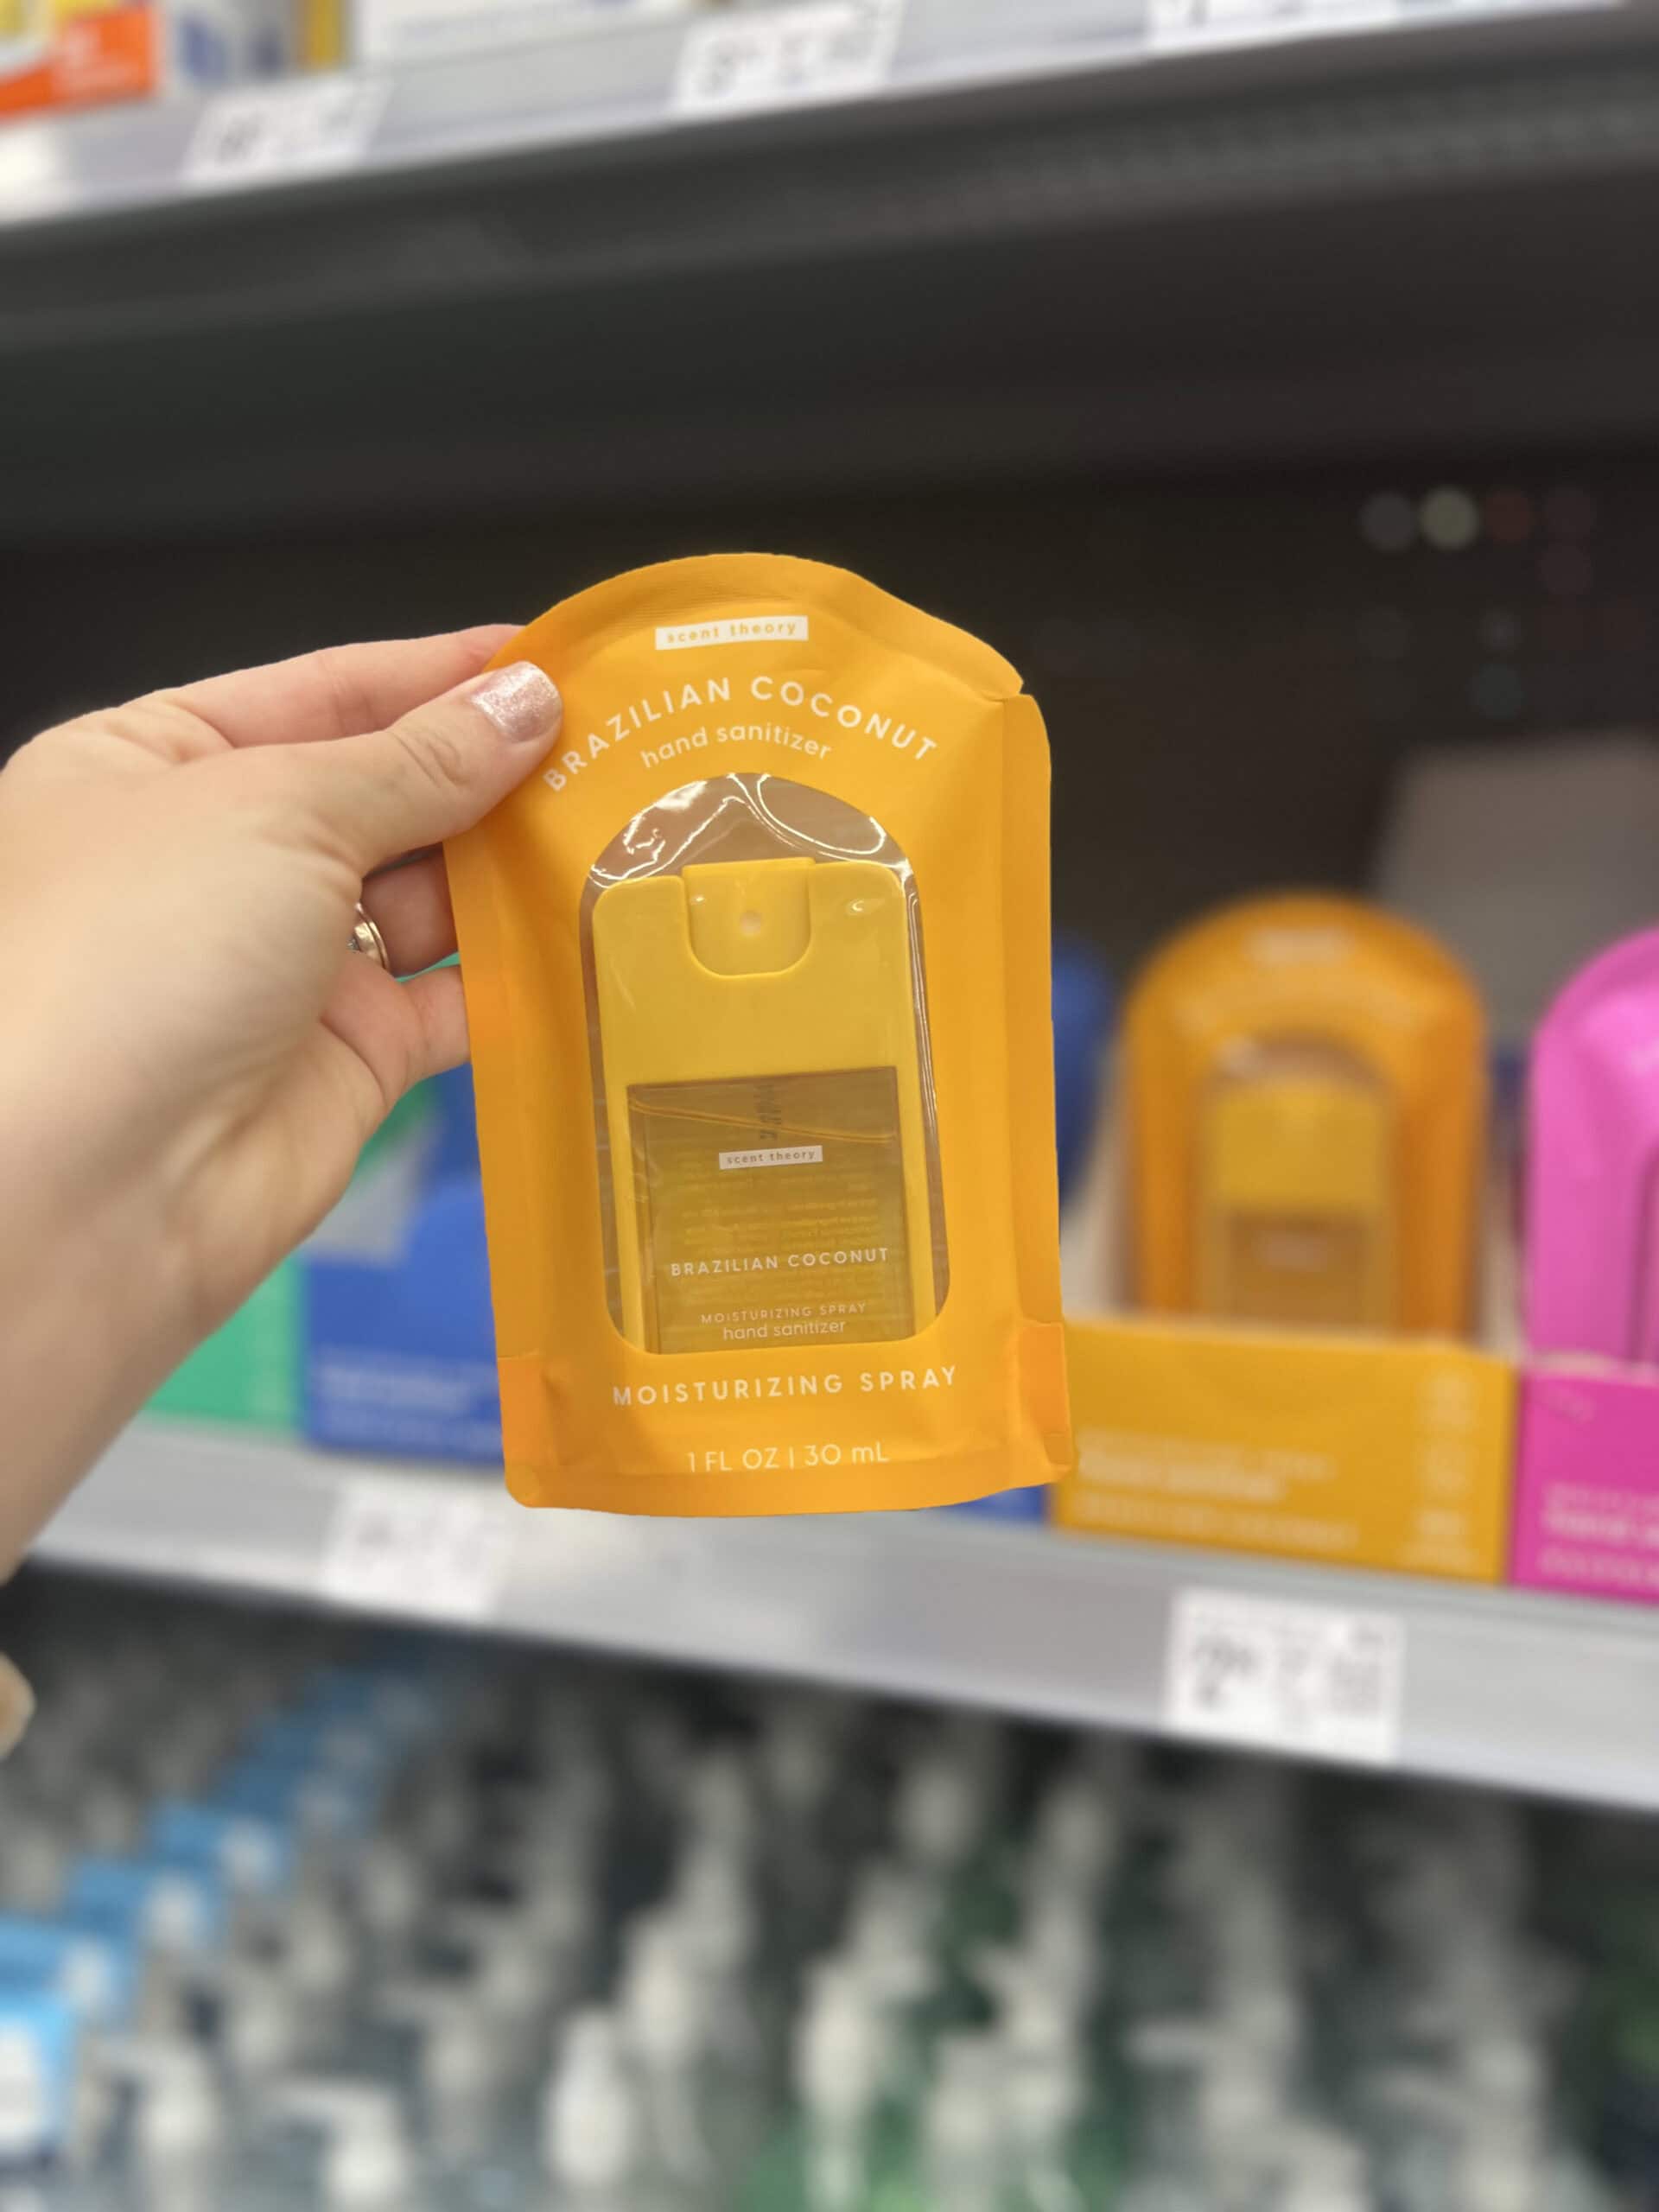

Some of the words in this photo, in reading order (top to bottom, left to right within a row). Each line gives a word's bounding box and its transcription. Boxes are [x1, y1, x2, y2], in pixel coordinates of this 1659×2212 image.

[667, 627, 719, 644] scent
[729, 620, 798, 638] theory
[543, 677, 732, 792] BRAZILIAN
[750, 676, 938, 761] COCONUT
[639, 726, 709, 768] hand
[716, 722, 832, 760] sanitizer
[727, 1153, 765, 1165] scent
[770, 1149, 817, 1162] theory
[671, 1255, 779, 1277] BRAZILIAN
[787, 1248, 889, 1268] COCONUT
[701, 1306, 812, 1325] MOISTURIZING
[819, 1303, 867, 1316] SPRAY
[723, 1325, 768, 1340] hand
[773, 1319, 846, 1337] sanitizer
[613, 1374, 843, 1406] MOISTURIZING
[860, 1365, 957, 1393] SPRAY
[686, 1452, 696, 1472] 1
[705, 1451, 732, 1472] FL
[742, 1447, 779, 1470] OZ
[804, 1444, 842, 1466] 30
[852, 1441, 891, 1464] mL
